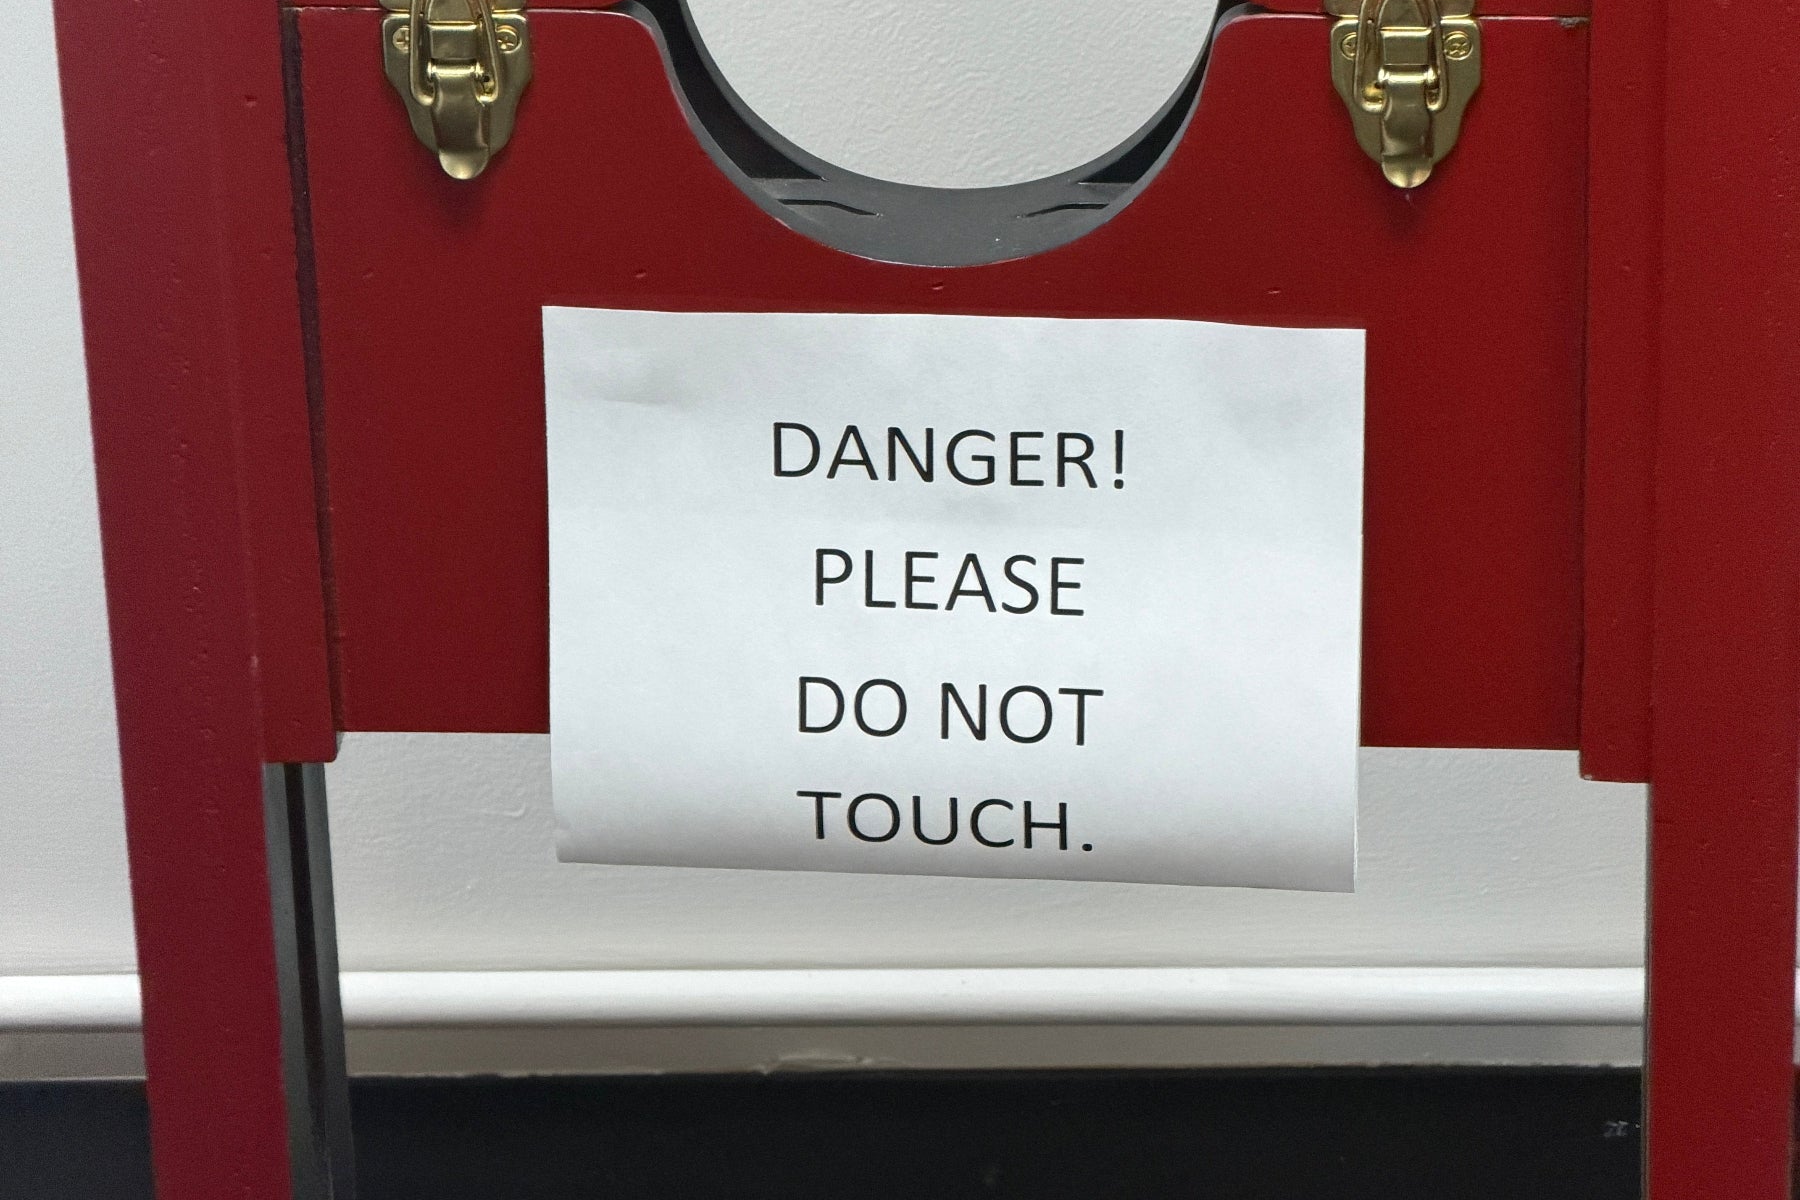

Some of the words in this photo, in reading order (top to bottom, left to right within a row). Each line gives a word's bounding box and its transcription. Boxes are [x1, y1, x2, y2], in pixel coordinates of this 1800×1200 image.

[772, 421, 1125, 490] DANGER!
[814, 548, 1085, 616] PLEASE
[798, 676, 908, 737] DO
[940, 682, 1104, 746] NOT
[796, 790, 1094, 853] TOUCH.
